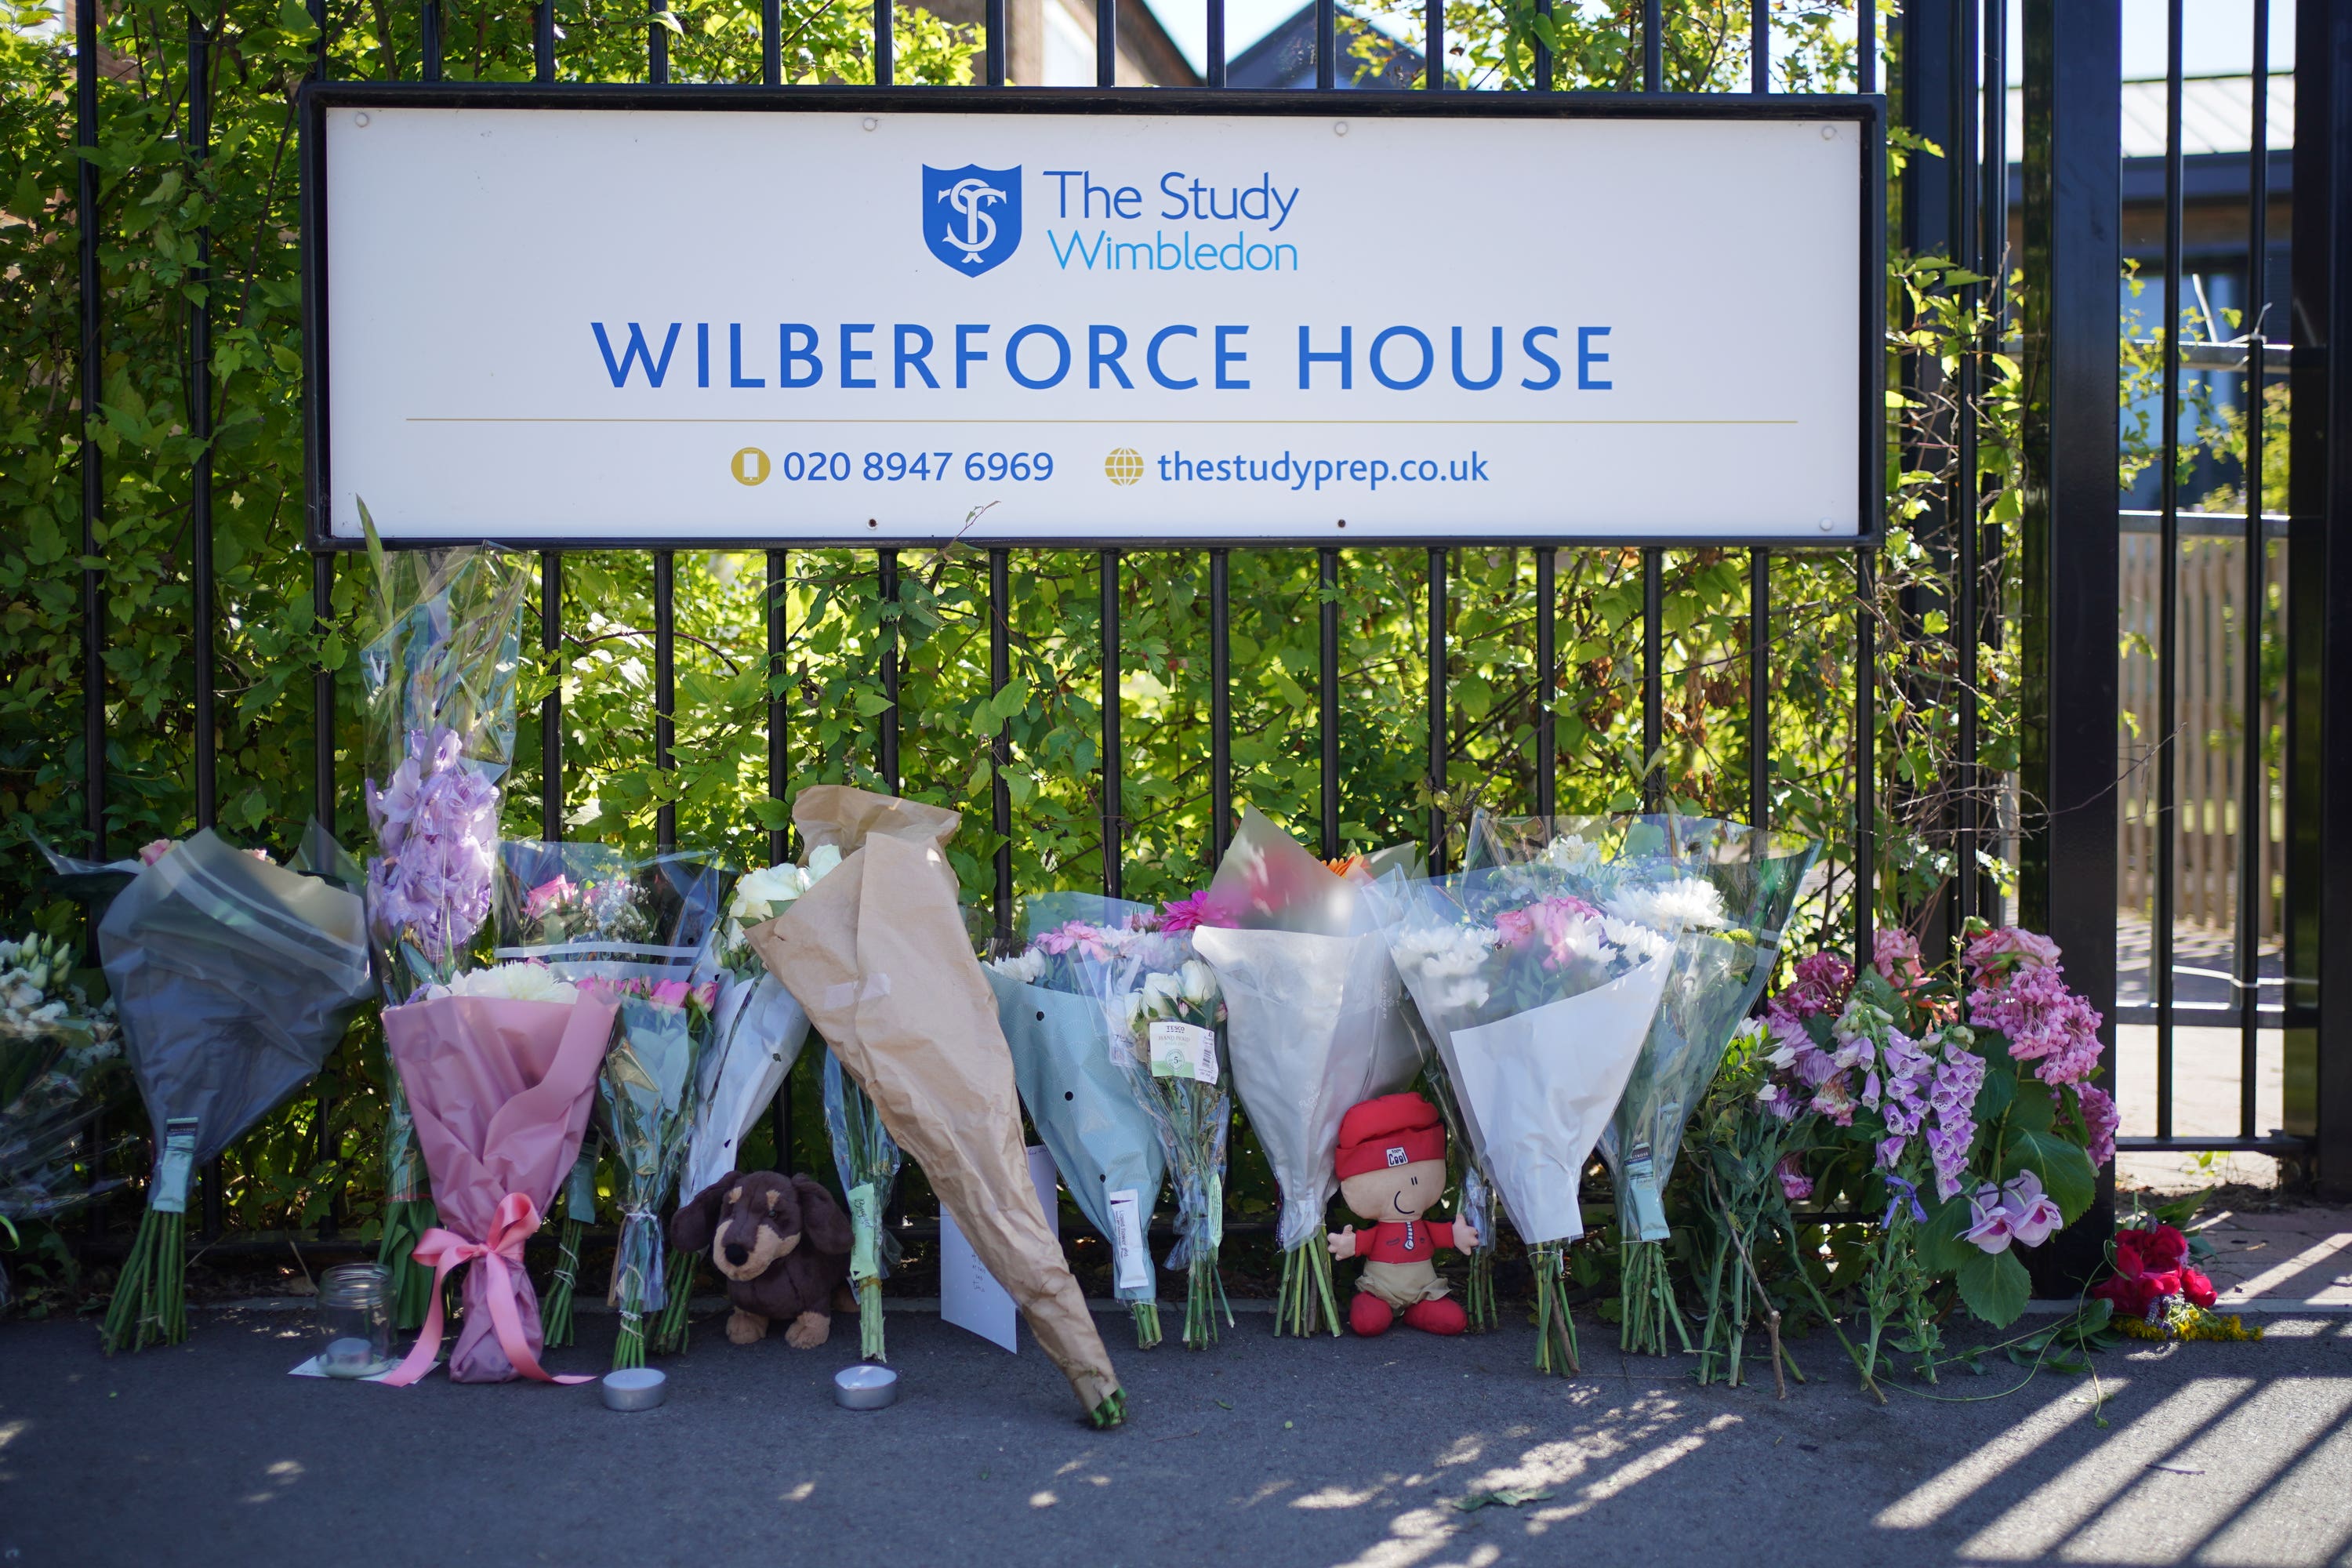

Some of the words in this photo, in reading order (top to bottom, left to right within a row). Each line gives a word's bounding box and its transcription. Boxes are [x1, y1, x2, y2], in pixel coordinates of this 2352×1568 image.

[1042, 170, 1142, 220] The
[1160, 171, 1300, 232] Study
[1046, 229, 1298, 271] Wimbledon
[590, 321, 1251, 390] WILBERFORCE
[1298, 325, 1613, 391] HOUSE
[783, 451, 851, 482] 020
[862, 451, 953, 482] 8947
[964, 452, 1054, 482] 6969
[1156, 450, 1490, 491] thestudyprep.co.uk
[1388, 1152, 1406, 1165] Cool
